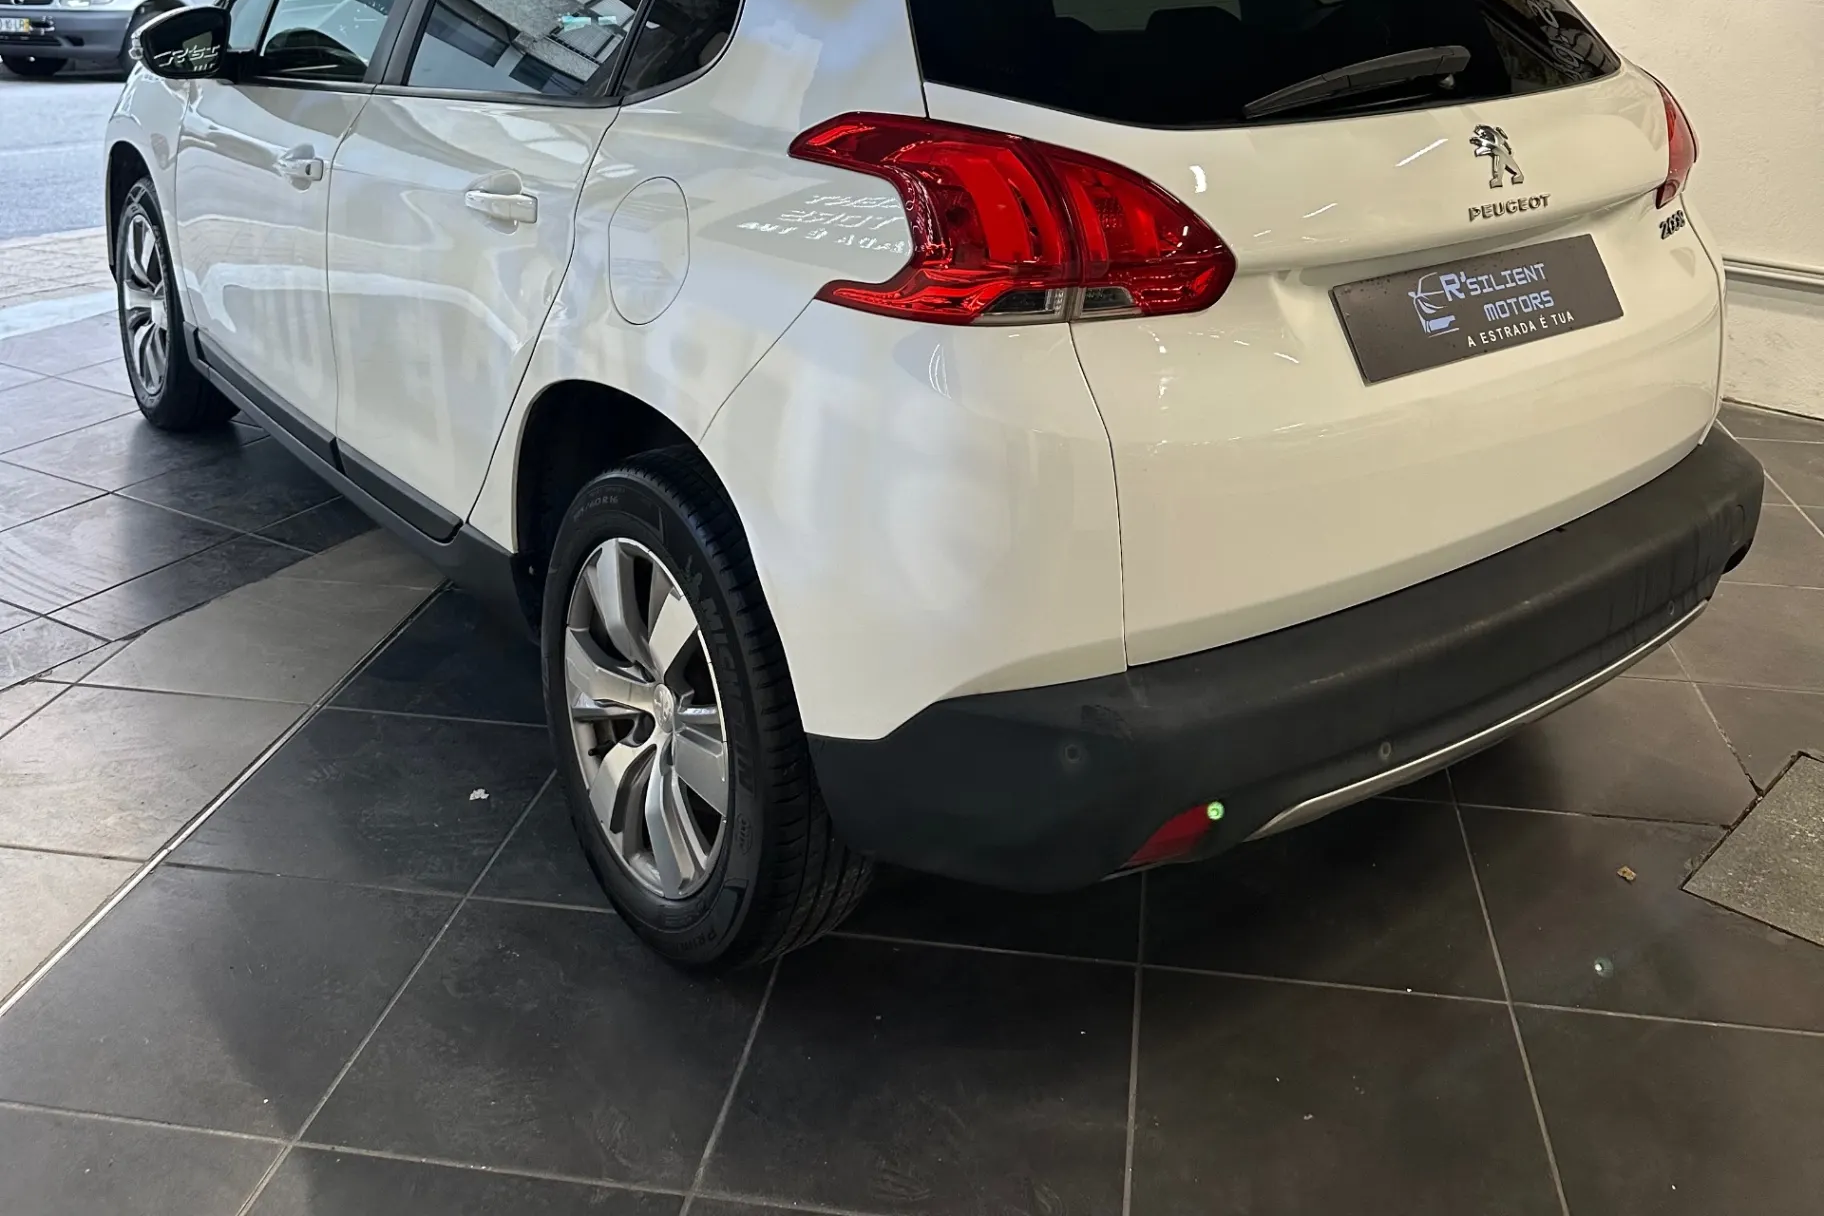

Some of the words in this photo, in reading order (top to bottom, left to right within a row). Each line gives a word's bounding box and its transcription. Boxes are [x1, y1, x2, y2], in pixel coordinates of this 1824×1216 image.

[1468, 193, 1551, 222] PEUGEOT
[1659, 209, 1686, 240] 2008
[1439, 263, 1547, 301] R'SILIENT
[1484, 290, 1555, 322] MOTORS
[1467, 336, 1477, 348] A
[1479, 320, 1537, 344] ESTRADA
[1539, 314, 1548, 329] É
[1551, 310, 1575, 326] TUA
